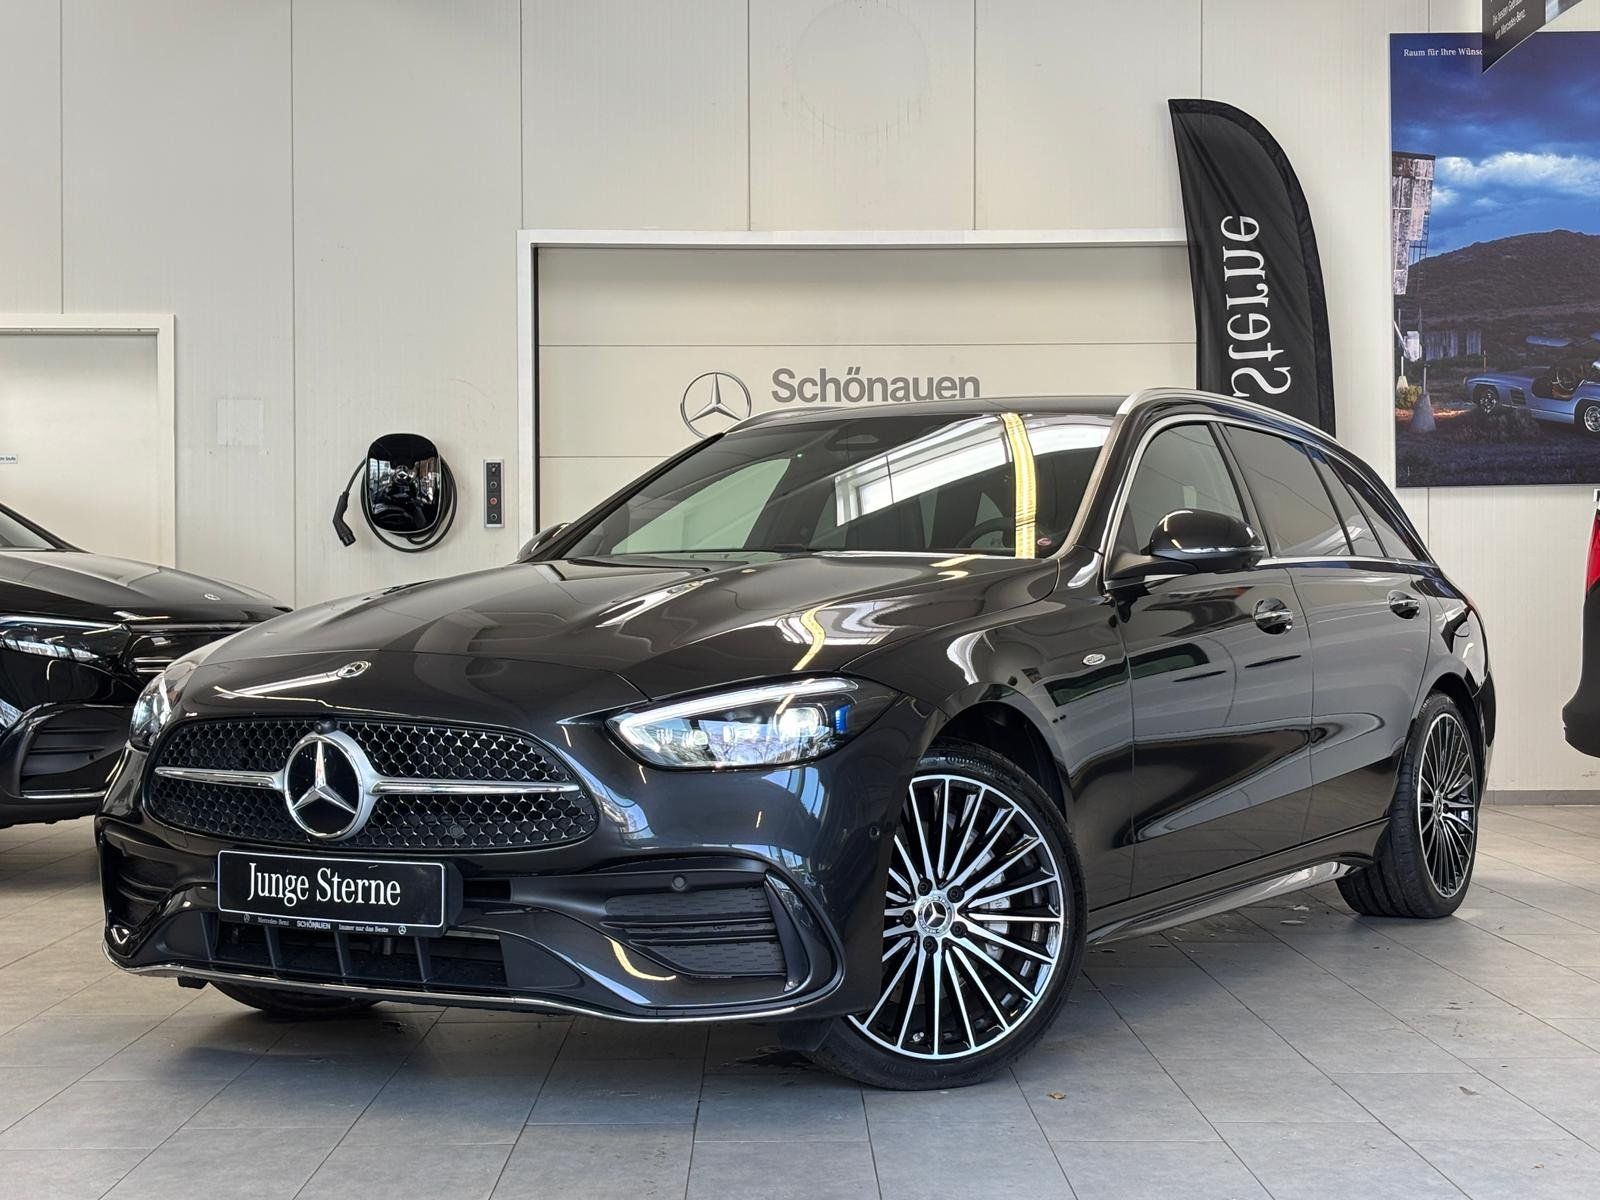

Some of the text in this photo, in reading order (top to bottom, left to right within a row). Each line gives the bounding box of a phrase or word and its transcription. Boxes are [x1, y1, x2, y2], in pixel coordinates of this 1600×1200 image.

[1404, 48, 1426, 57] Raum
[1427, 48, 1439, 57] für
[1441, 48, 1457, 56] Ihre
[771, 366, 981, 403] Schönauen
[247, 862, 401, 907] Junge Sterne
